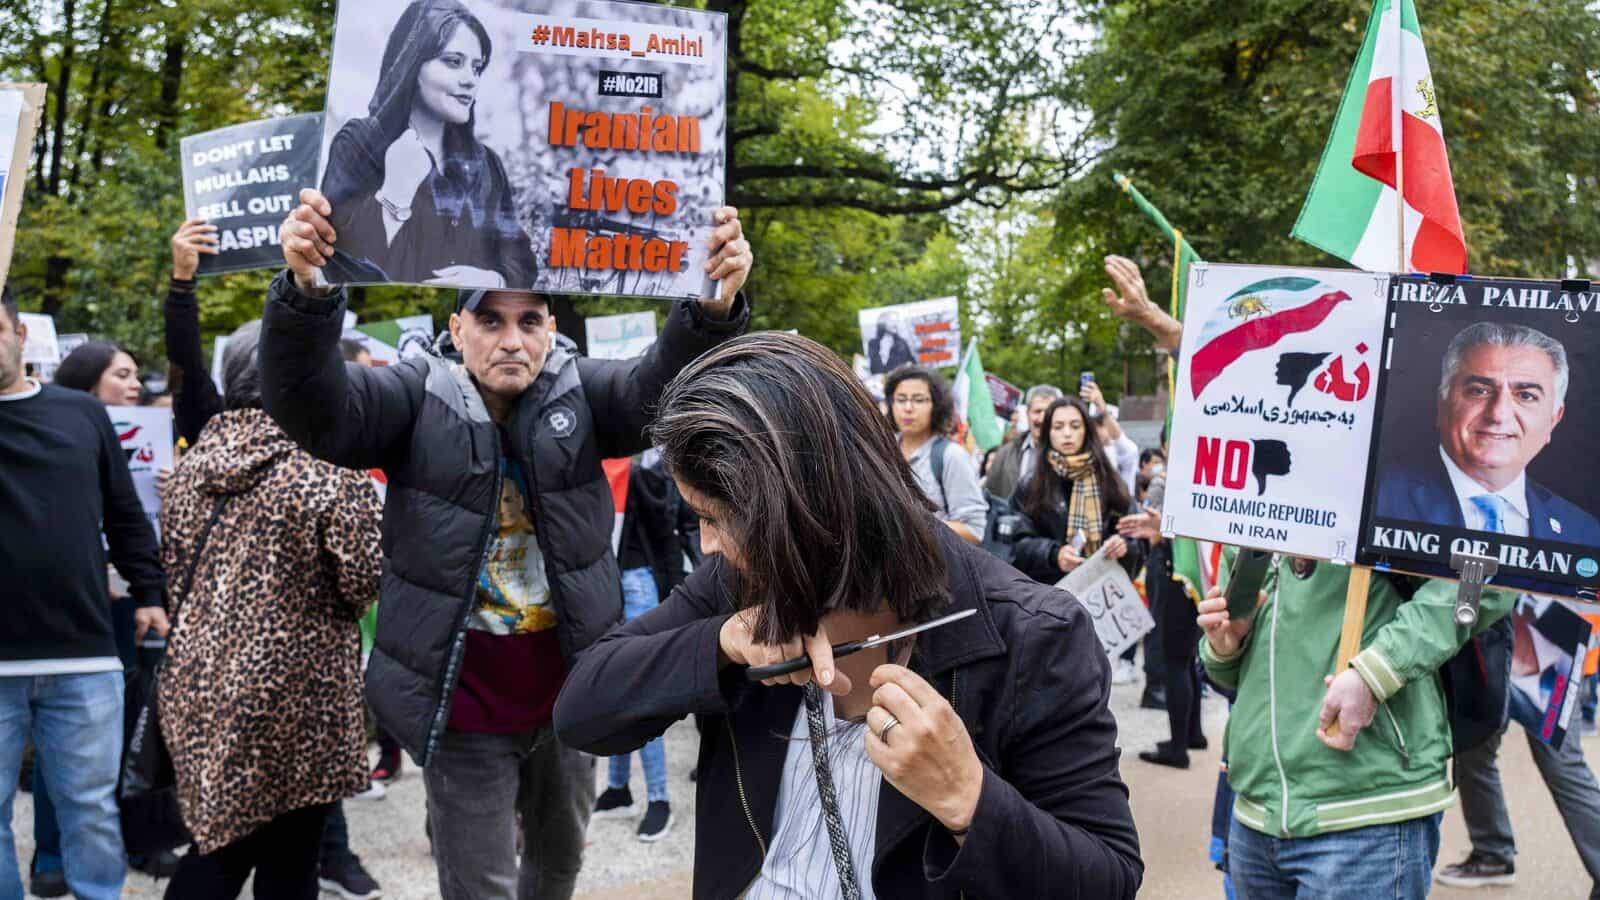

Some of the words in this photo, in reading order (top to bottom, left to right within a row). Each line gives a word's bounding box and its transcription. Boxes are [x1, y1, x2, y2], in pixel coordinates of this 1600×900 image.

[531, 24, 704, 58] #Mahsa_Amini
[602, 74, 659, 95] #No2IR
[548, 100, 701, 153] Iranian
[193, 140, 255, 167] DON'T
[260, 134, 293, 153] LET
[195, 165, 289, 194] MULLAHS
[568, 167, 679, 217] Lives
[197, 202, 245, 219] SELL
[248, 195, 293, 215] OUT
[549, 227, 689, 273] Matter
[1313, 341, 1370, 402] نه
[1193, 436, 1250, 490] NO
[1191, 492, 1208, 509] TO
[1209, 495, 1266, 518] ISLAMIC
[1268, 503, 1337, 528] REPUBLIC
[1228, 522, 1244, 535] IN
[1249, 525, 1288, 541] IRAN
[1372, 526, 1440, 555] KING
[1498, 543, 1572, 575] IRAN
